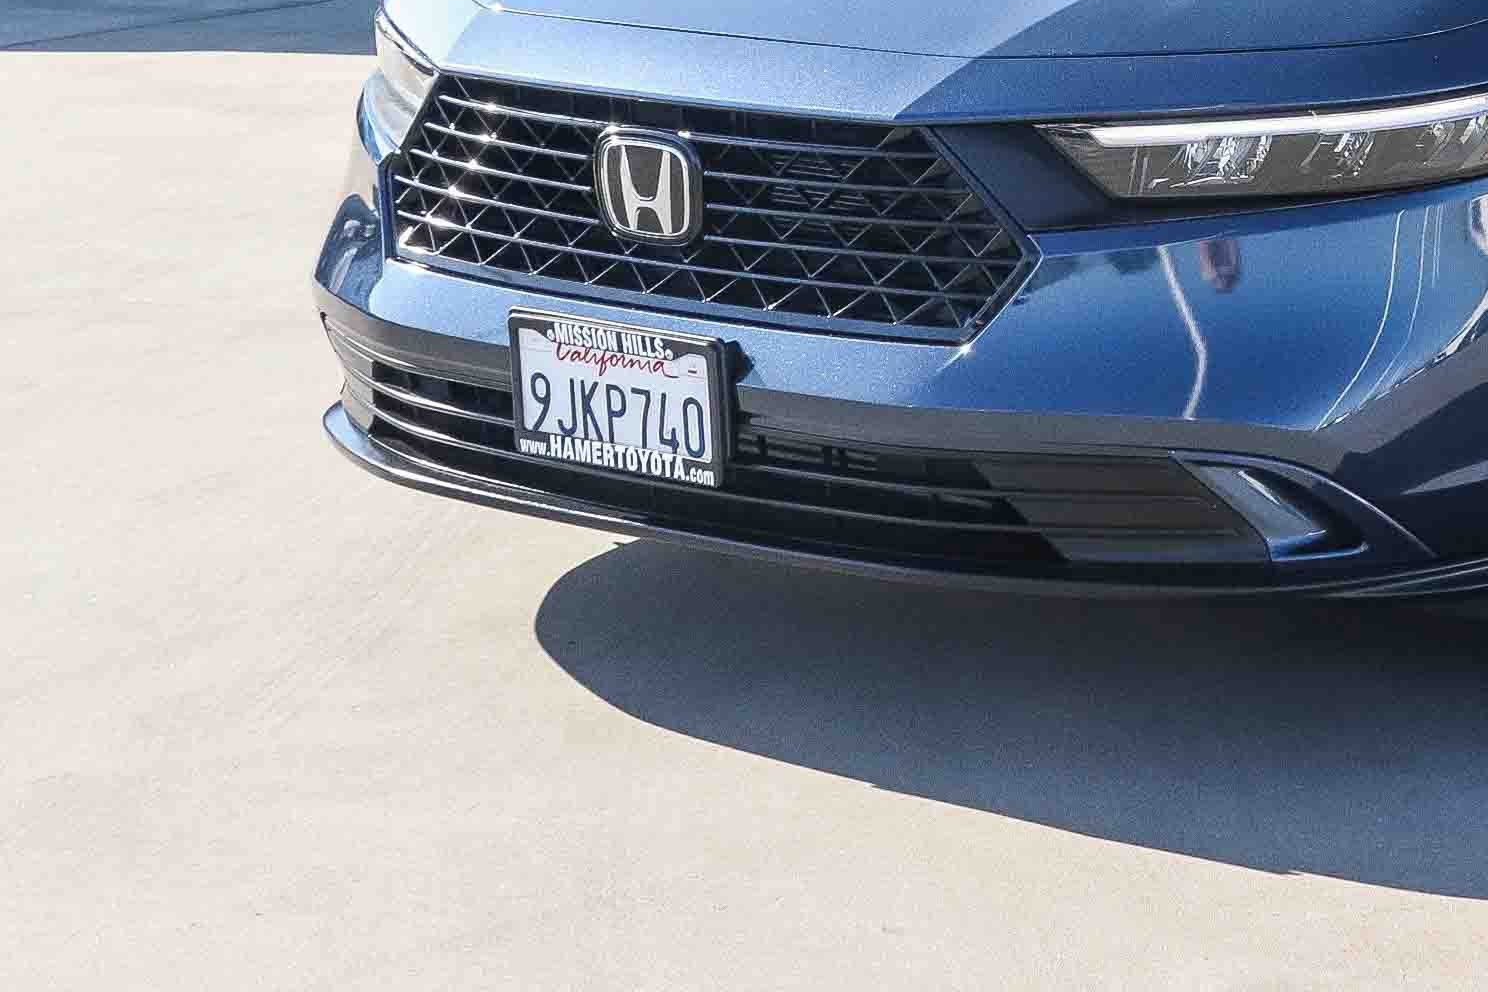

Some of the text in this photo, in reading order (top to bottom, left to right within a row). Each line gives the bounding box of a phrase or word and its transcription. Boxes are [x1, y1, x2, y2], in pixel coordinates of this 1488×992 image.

[554, 322, 665, 359] MISSION HILLS
[554, 340, 680, 378] California
[530, 372, 706, 459] 9JKP740
[519, 434, 715, 487] www.HAMERTOYOTA.com
